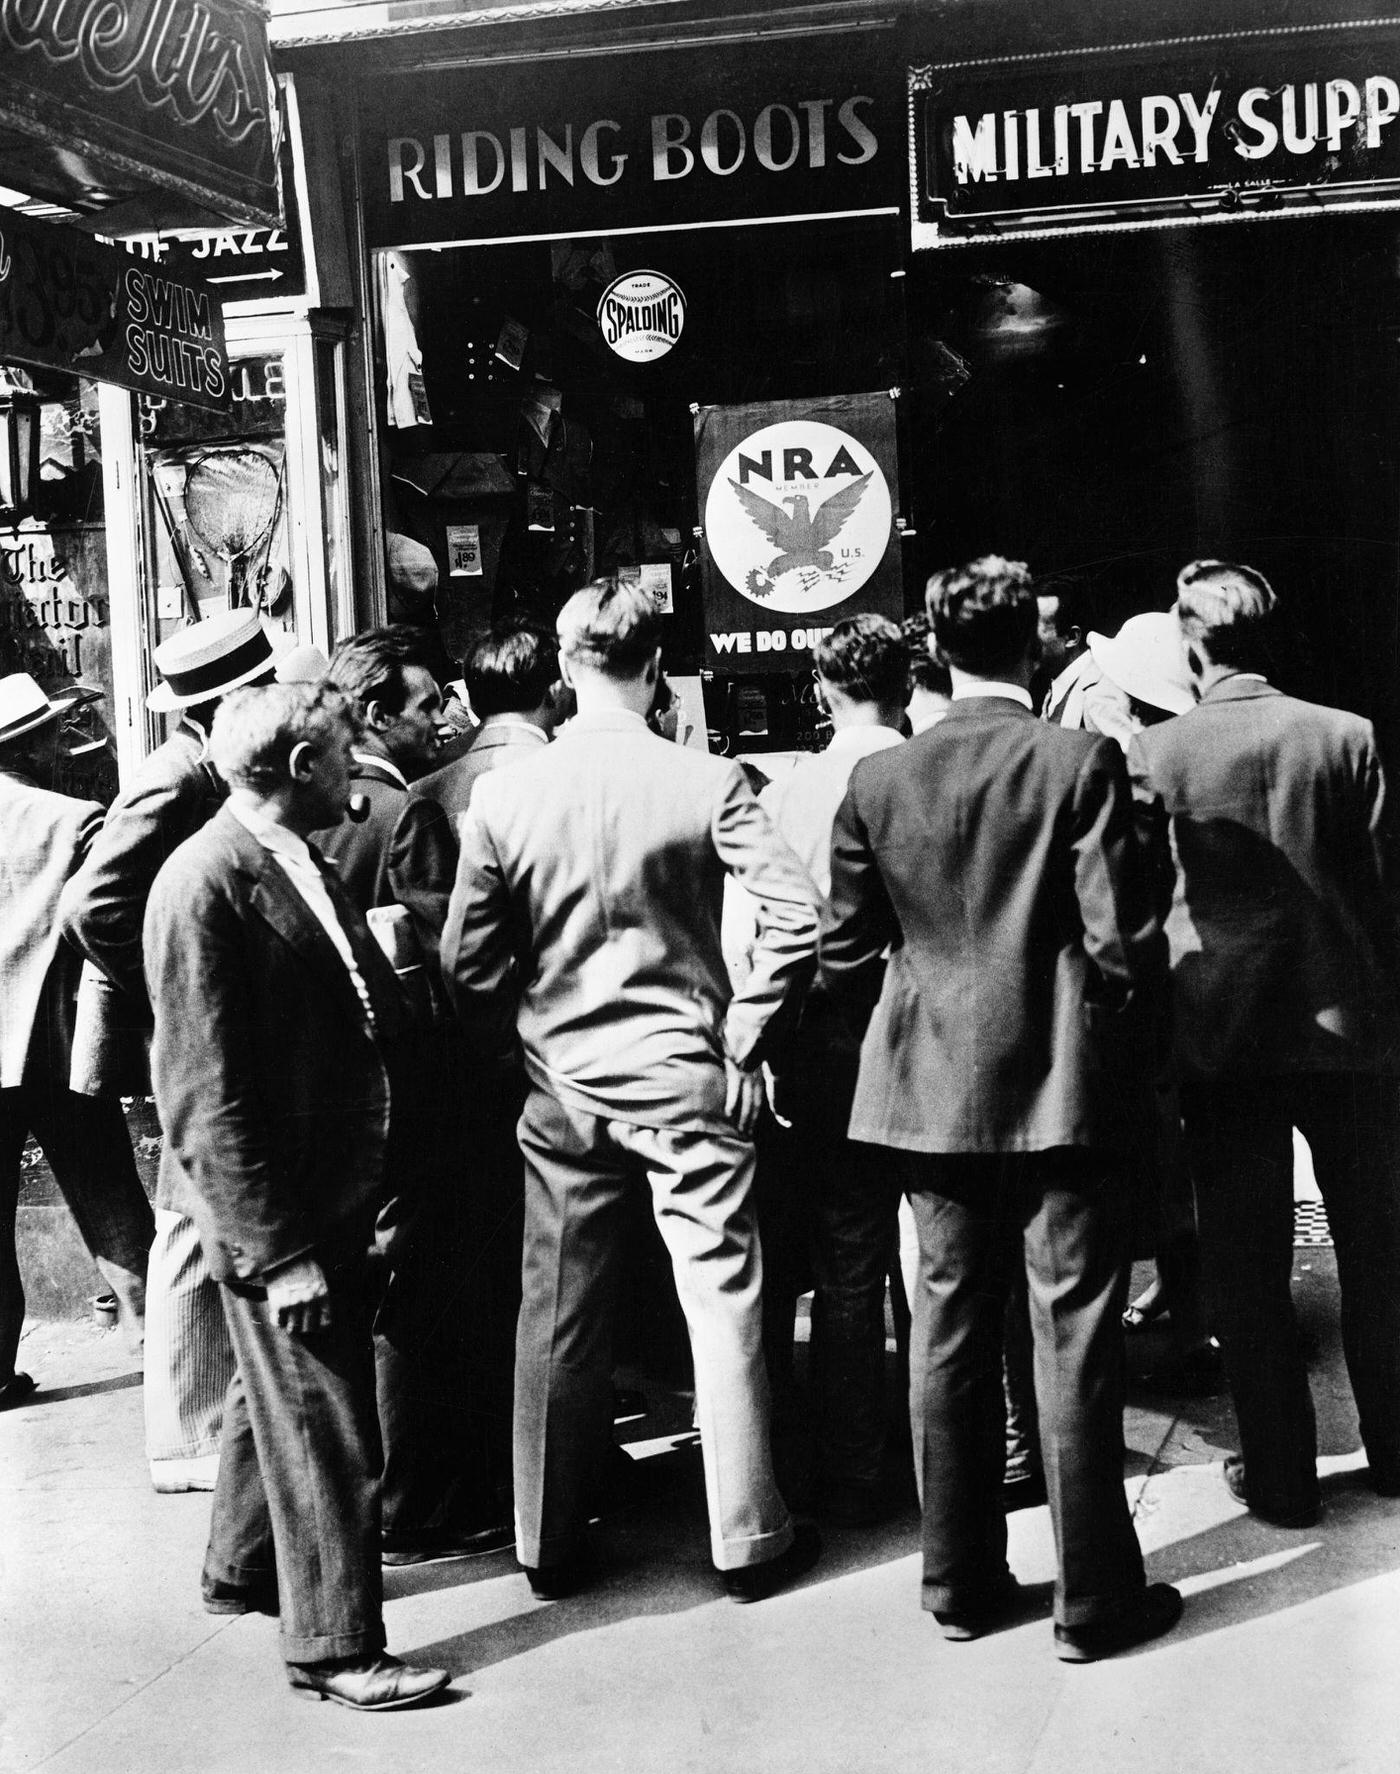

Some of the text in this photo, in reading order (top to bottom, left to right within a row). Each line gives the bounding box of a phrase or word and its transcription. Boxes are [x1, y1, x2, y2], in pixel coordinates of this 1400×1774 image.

[387, 95, 879, 202] RIDING BOOTS
[952, 76, 1400, 185] MILITARY SUPP
[125, 268, 212, 341] SWIM
[606, 292, 680, 345] SPALDING
[125, 323, 225, 398] SUITS
[738, 444, 864, 485] NRA
[709, 632, 752, 655] WE
[756, 630, 787, 652] DO
